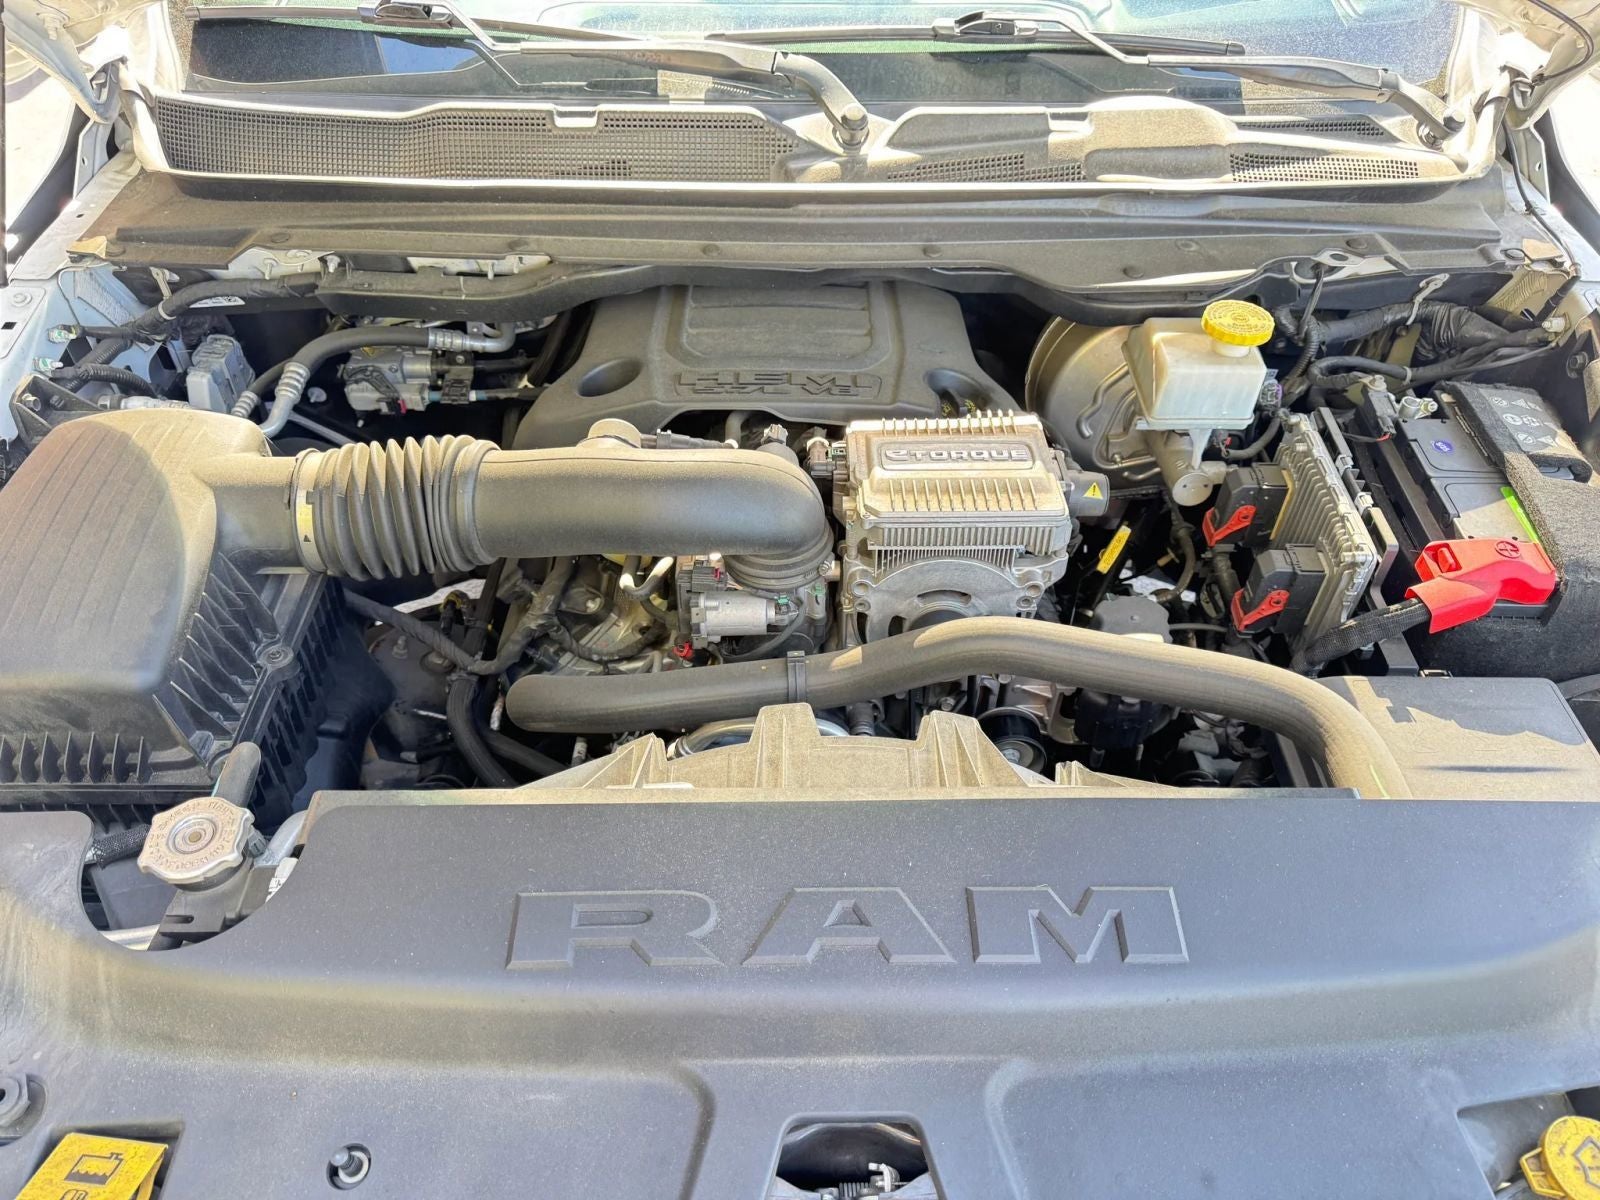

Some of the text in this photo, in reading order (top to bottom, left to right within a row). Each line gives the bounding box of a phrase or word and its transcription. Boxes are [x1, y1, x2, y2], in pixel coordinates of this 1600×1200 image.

[676, 371, 873, 389] HEMI
[692, 384, 860, 397] 5.7L V8
[506, 885, 1190, 967] RAM
